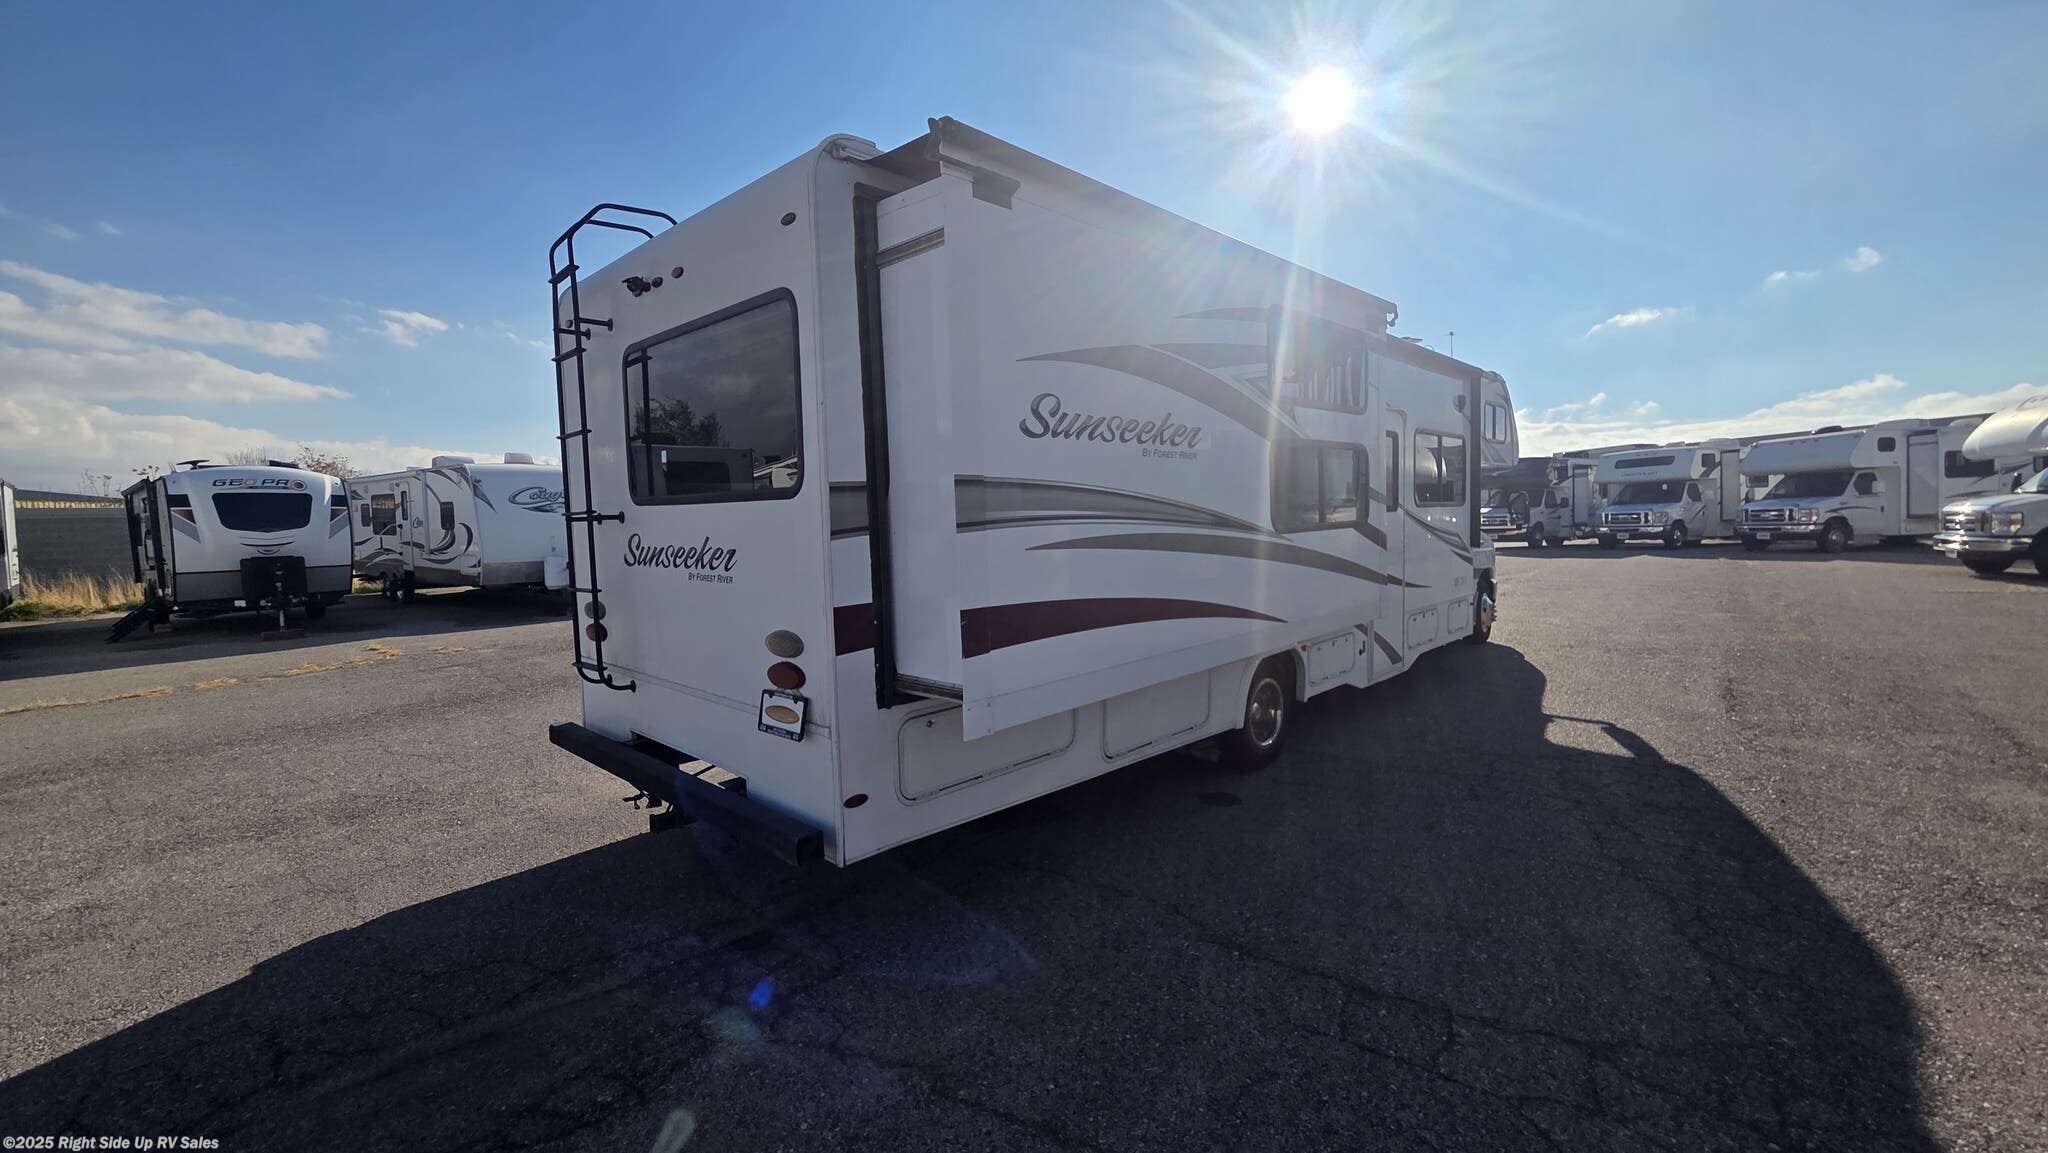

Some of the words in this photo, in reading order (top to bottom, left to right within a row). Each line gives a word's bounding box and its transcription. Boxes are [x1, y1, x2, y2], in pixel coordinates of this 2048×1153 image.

[1019, 392, 1203, 449] Sunseeker
[1142, 449, 1152, 457] BY
[1153, 449, 1178, 459] FOREST
[212, 478, 257, 487] GEO
[623, 533, 738, 572] Sunseeker
[688, 572, 696, 581] BY
[696, 572, 716, 583] FOREST
[717, 574, 734, 584] RIVER
